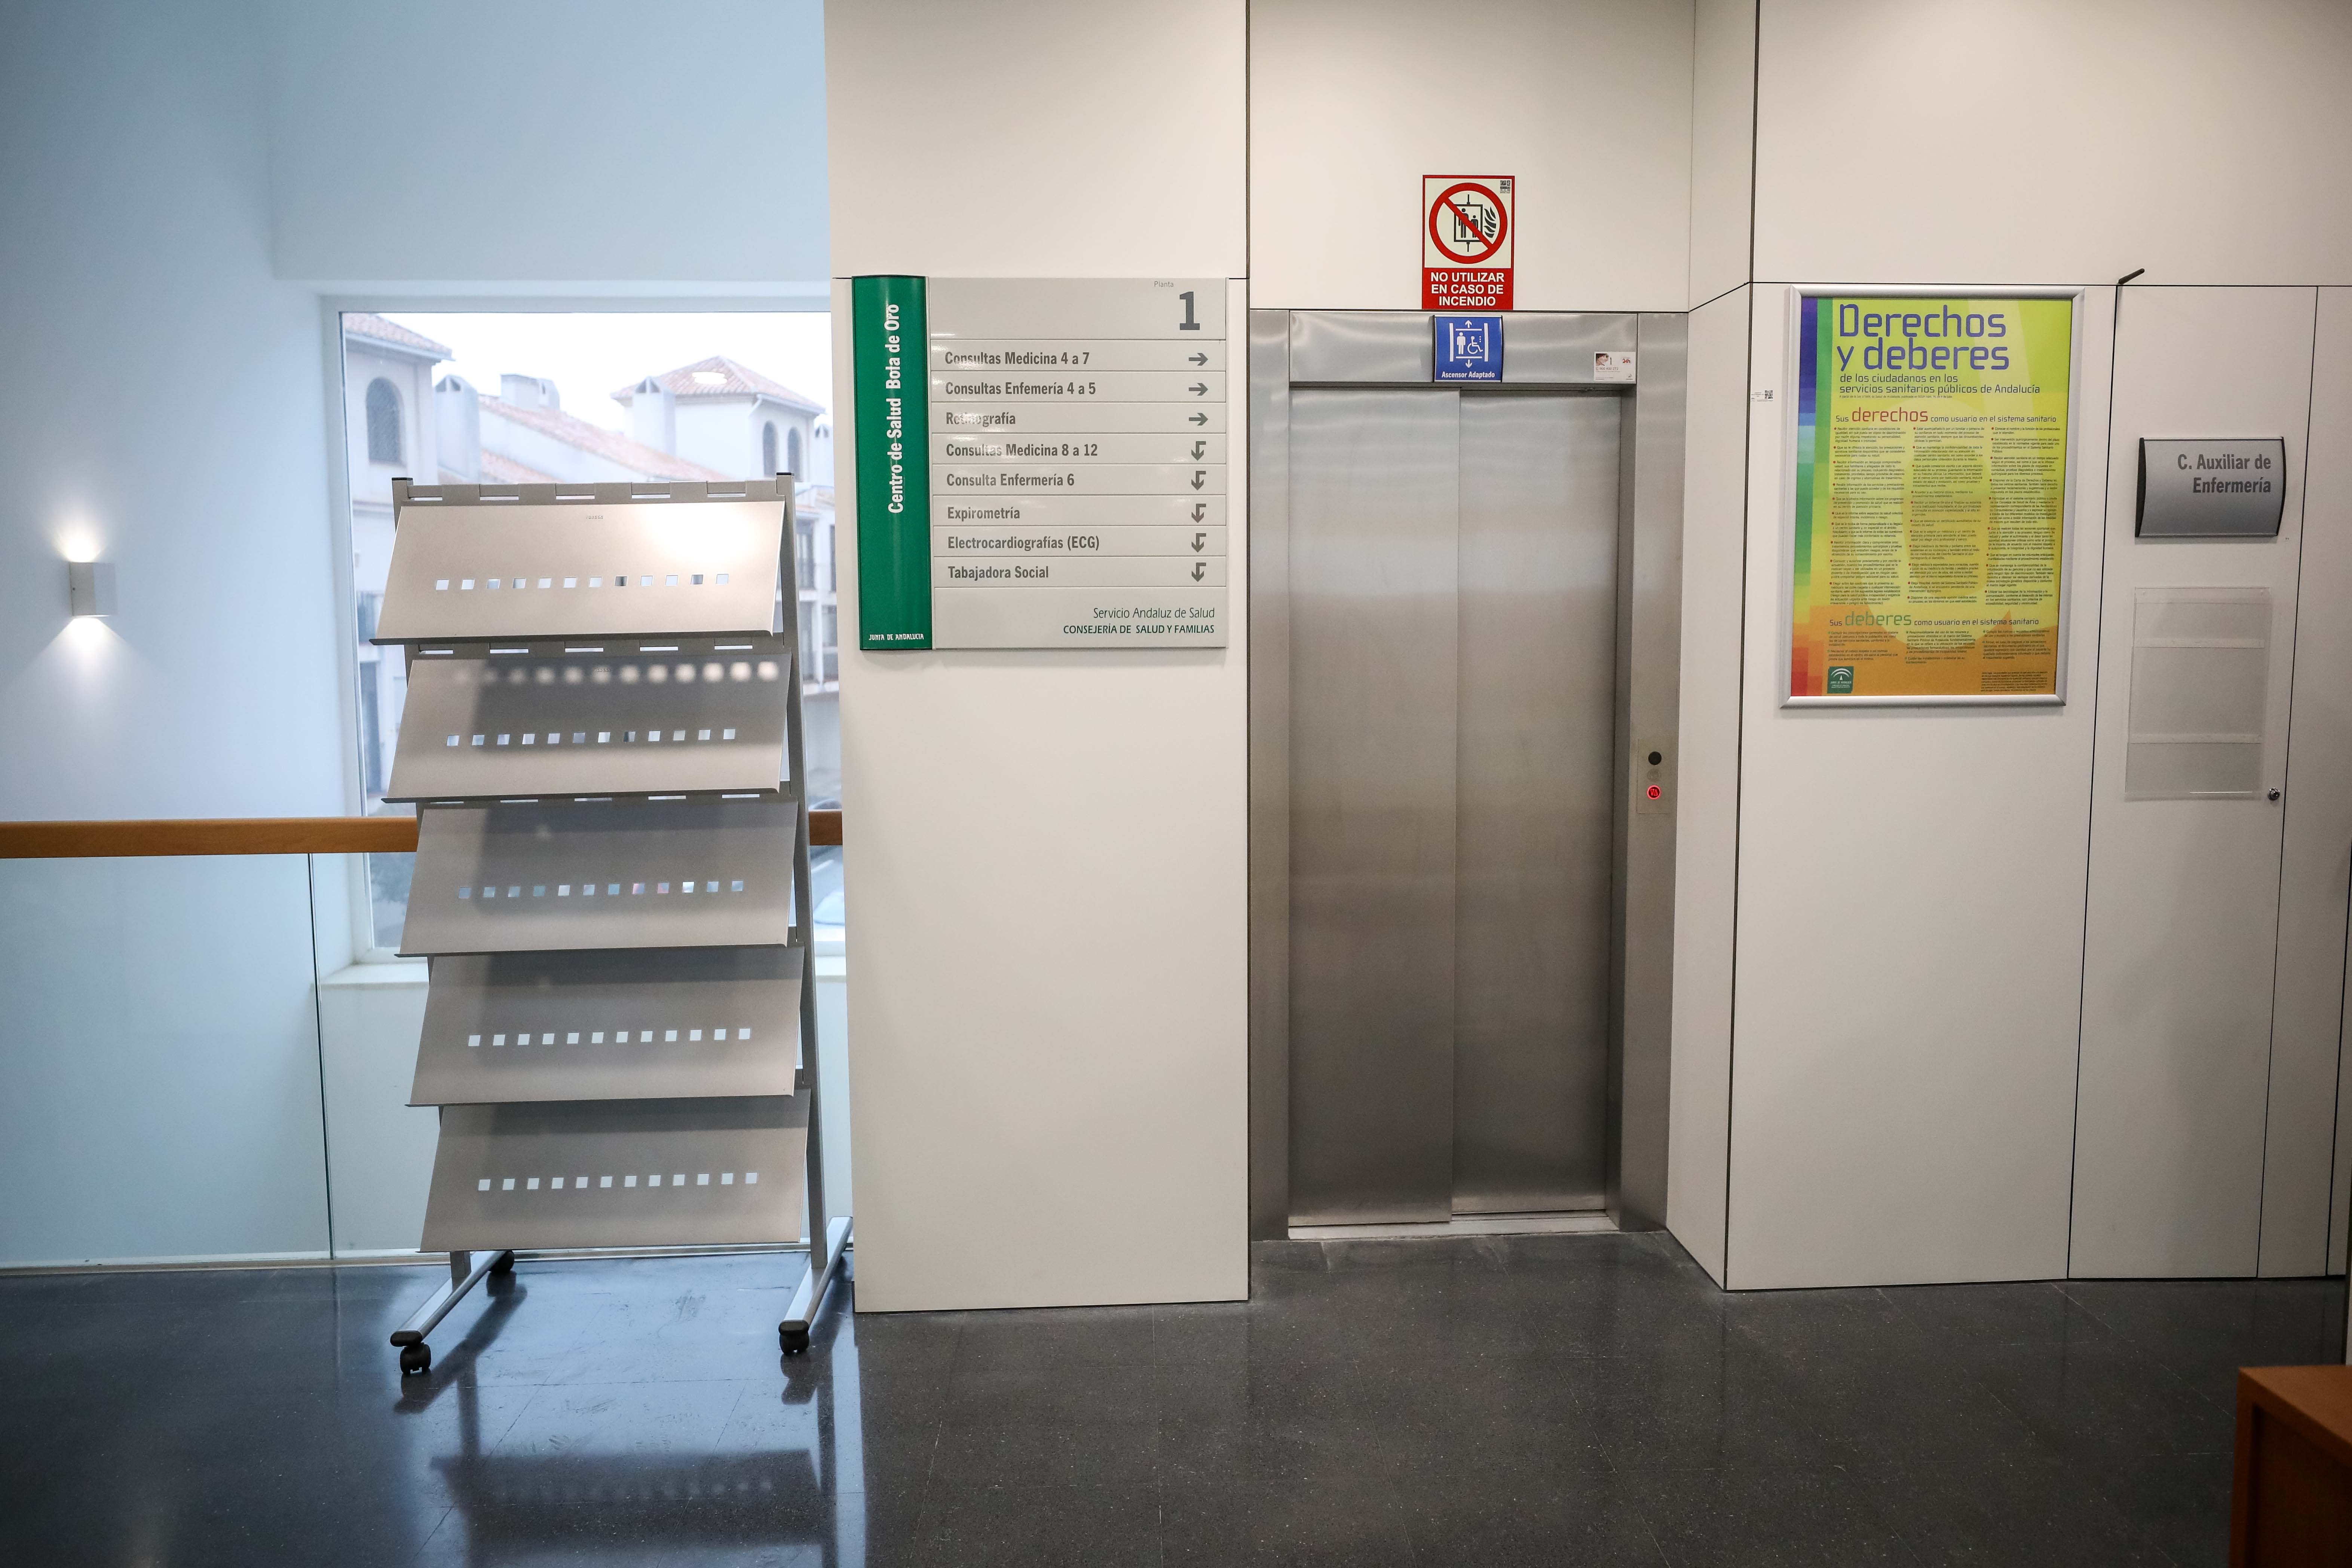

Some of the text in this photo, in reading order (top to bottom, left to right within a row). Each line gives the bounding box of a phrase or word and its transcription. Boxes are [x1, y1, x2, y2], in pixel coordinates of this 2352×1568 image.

[1154, 279, 1174, 288] Planta
[1431, 272, 1505, 282] NO UTILIZAR
[1431, 284, 1504, 294] EN CASO DE
[1439, 296, 1496, 306] INCENDIO
[1179, 291, 1200, 331] 1
[1840, 304, 2006, 337] Derechos
[945, 351, 1090, 365] Consultas Medicina 4 a 7
[1837, 337, 2009, 372] y deberes
[1469, 371, 1495, 379] Adaptado
[1840, 373, 1852, 383] de
[1855, 373, 1869, 382] los
[1872, 373, 1926, 383] ciudadanos
[1944, 373, 1958, 383] los
[945, 382, 1096, 395] Consultas Enfemería 4 a 5
[1840, 384, 2040, 396] servicios sanitarios públicos de Andalucía
[884, 304, 904, 514] Centro de Salud Bola de Oro
[1852, 407, 1928, 422] derechos
[946, 411, 1016, 427] Reografía
[946, 443, 1098, 457] Consultas Medicina 8 a 12
[2177, 453, 2272, 470] C. Auxiliar de
[946, 473, 1075, 486] Consulta Enfermería 6
[2193, 477, 2272, 493] Enfermería
[947, 506, 1020, 522] Expirometría
[948, 535, 1099, 552] Electrocardiografías (ECG)
[947, 566, 1049, 582] Tabajadora Social
[1093, 607, 1215, 619] Servicio Andaluz de Salud
[1845, 610, 1912, 627] deberes
[1063, 623, 1214, 634] CONSEJERÍA DE SALUD Y FAMILIAS
